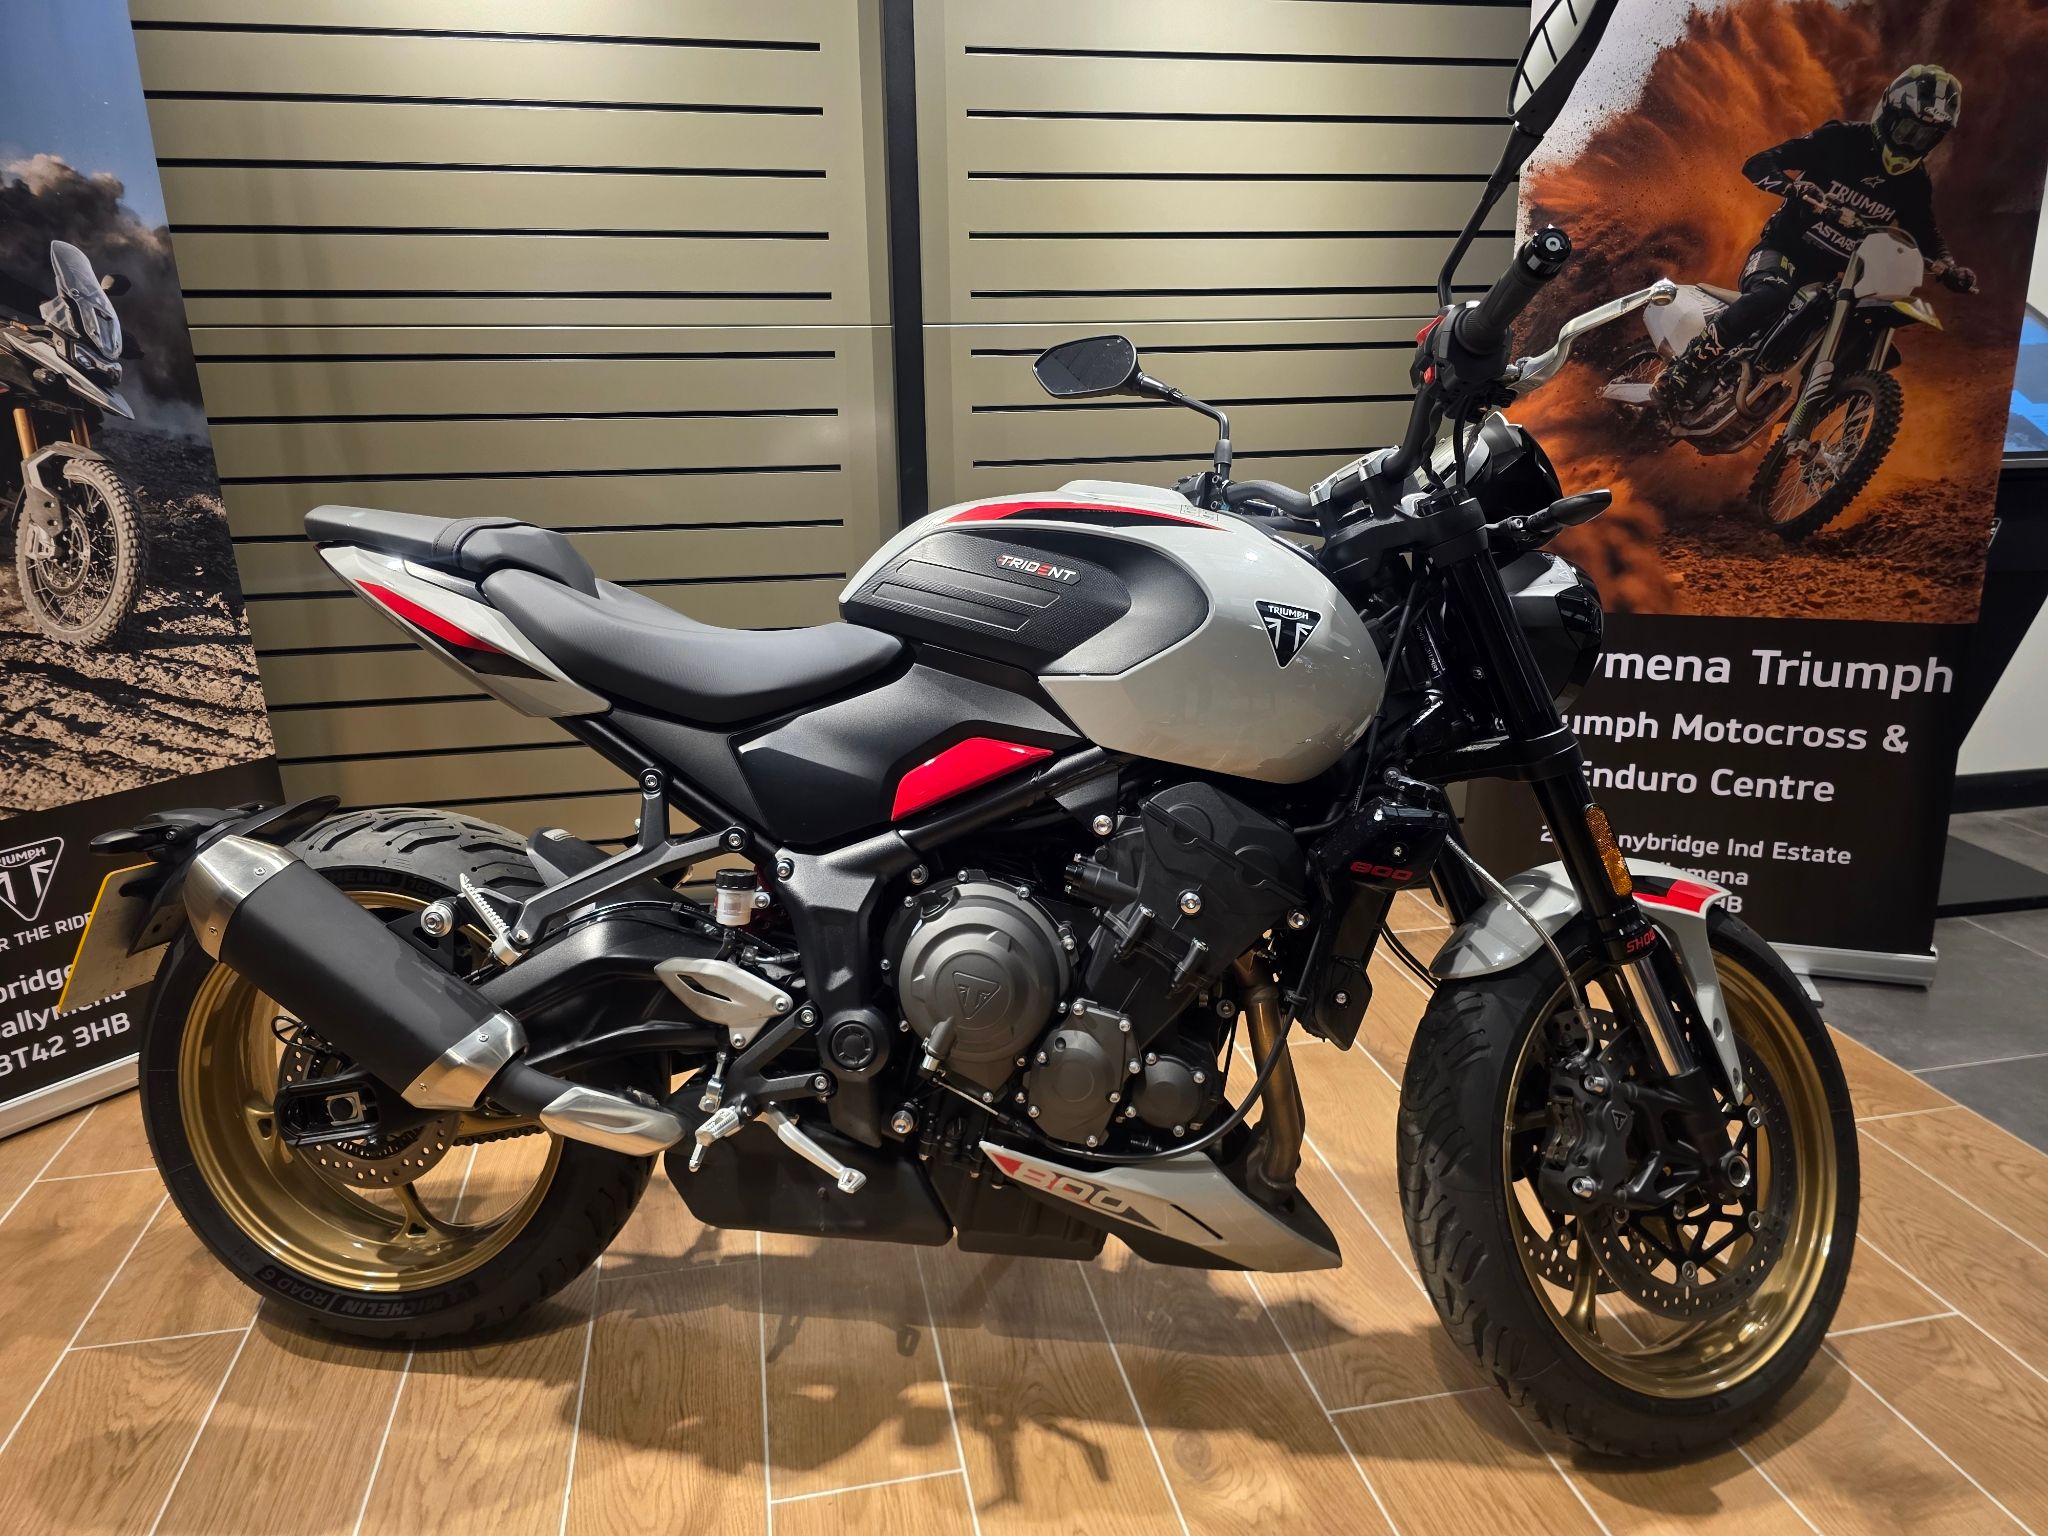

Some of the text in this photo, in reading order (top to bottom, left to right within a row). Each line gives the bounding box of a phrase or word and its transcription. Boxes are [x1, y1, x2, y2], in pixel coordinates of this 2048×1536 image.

[1829, 180, 1896, 222] TRIUMPH
[1000, 555, 1077, 580] TRIDENT
[1267, 605, 1309, 620] TRIUMPH
[1752, 649, 1954, 699] Triumph
[1672, 713, 1867, 750] Motocross
[1882, 724, 1909, 754] &
[1710, 768, 1835, 802] Centre
[0, 846, 46, 866] IUMPH
[1727, 838, 1763, 858] Ind
[1773, 842, 1852, 865] Estate
[1350, 861, 1414, 881] 800
[13, 925, 52, 946] THE
[72, 1012, 131, 1048] 3HB
[1014, 1163, 1131, 1214] 800
[262, 1265, 444, 1318] MICHELIN ROAD 6
